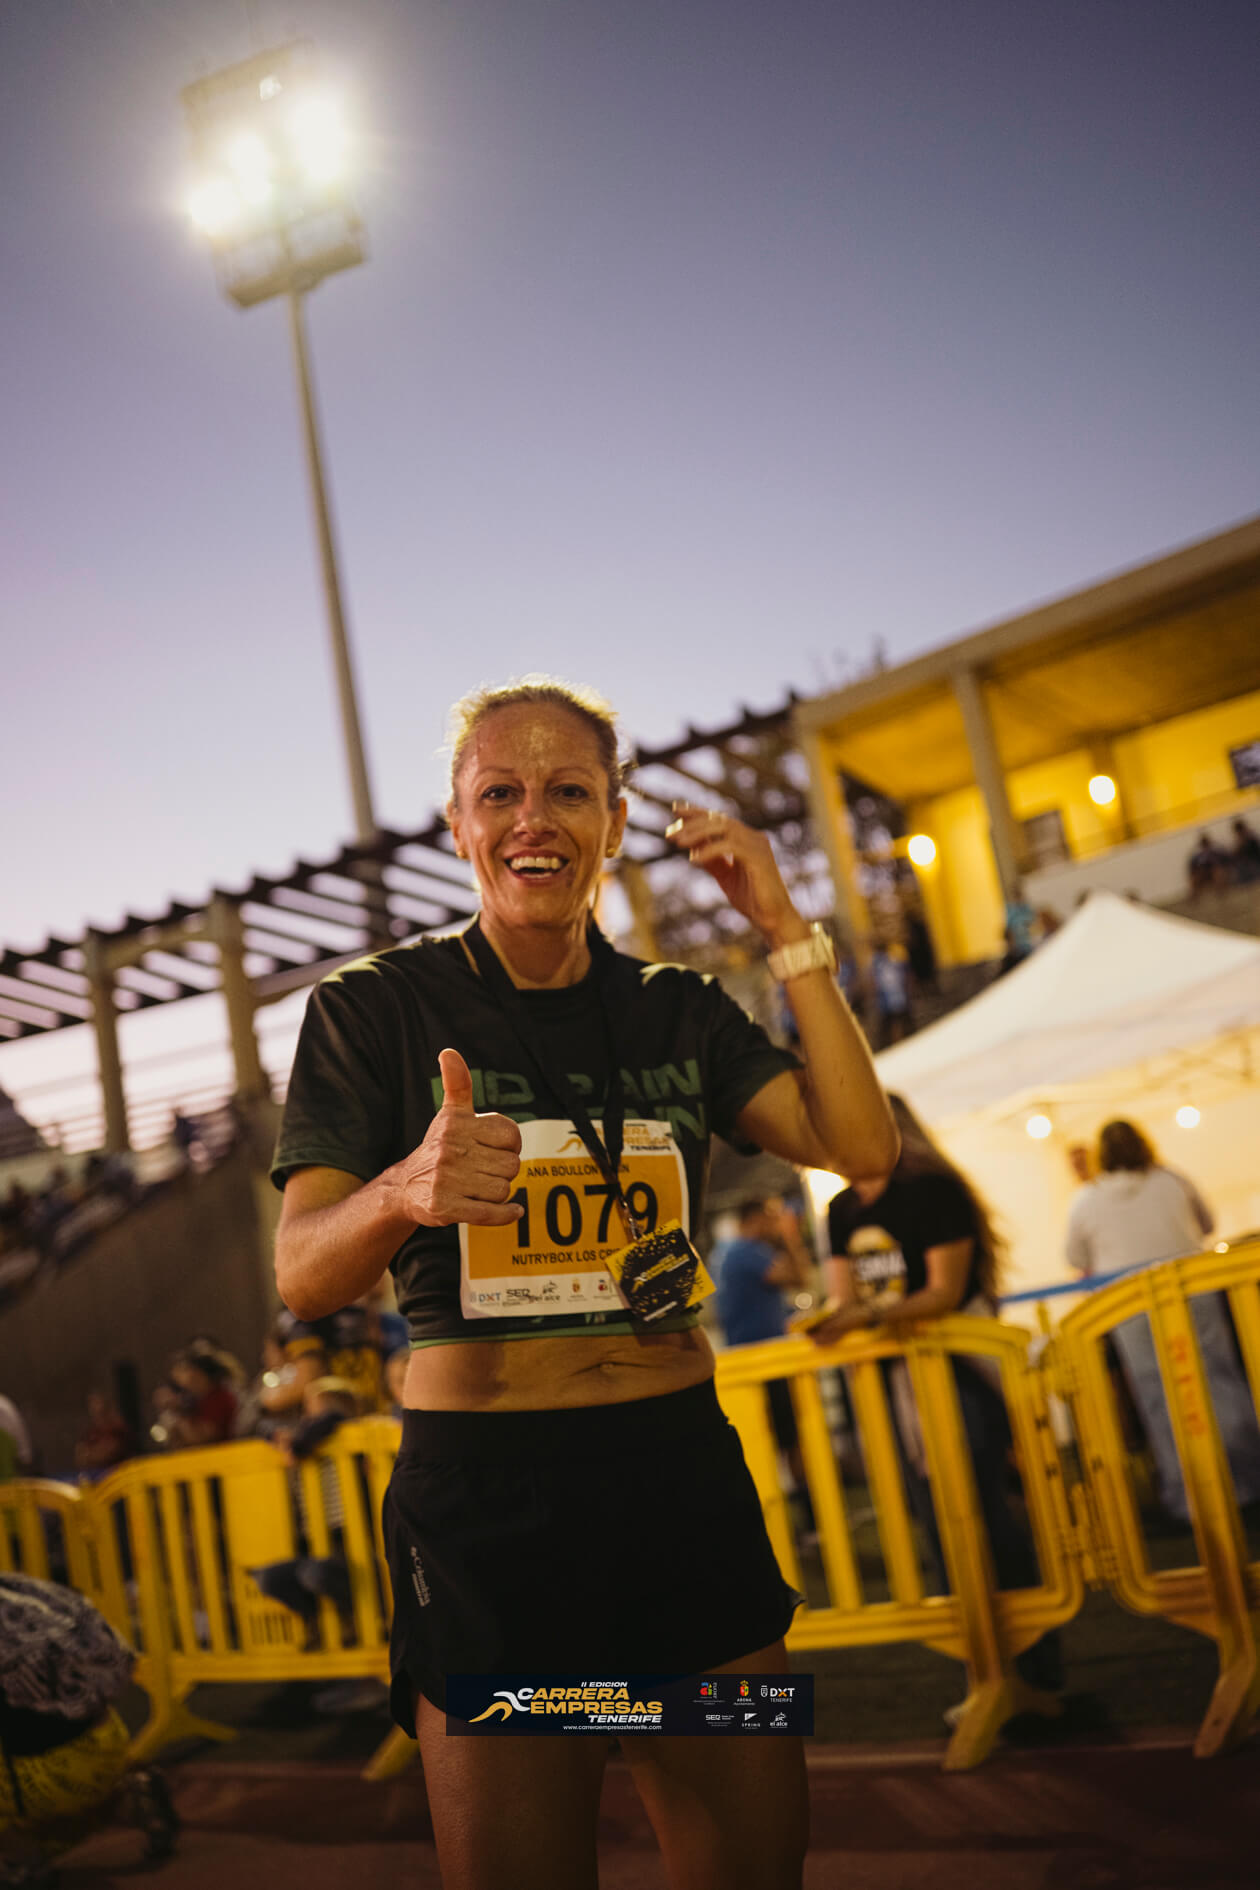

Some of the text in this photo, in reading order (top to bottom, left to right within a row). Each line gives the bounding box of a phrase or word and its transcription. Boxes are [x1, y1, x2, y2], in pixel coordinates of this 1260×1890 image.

[527, 1167, 549, 1177] ANA
[551, 1164, 599, 1177] BOULLON
[509, 1182, 658, 1248] 1079
[511, 1252, 574, 1265] NUTRYBOX
[576, 1250, 597, 1262] LOS
